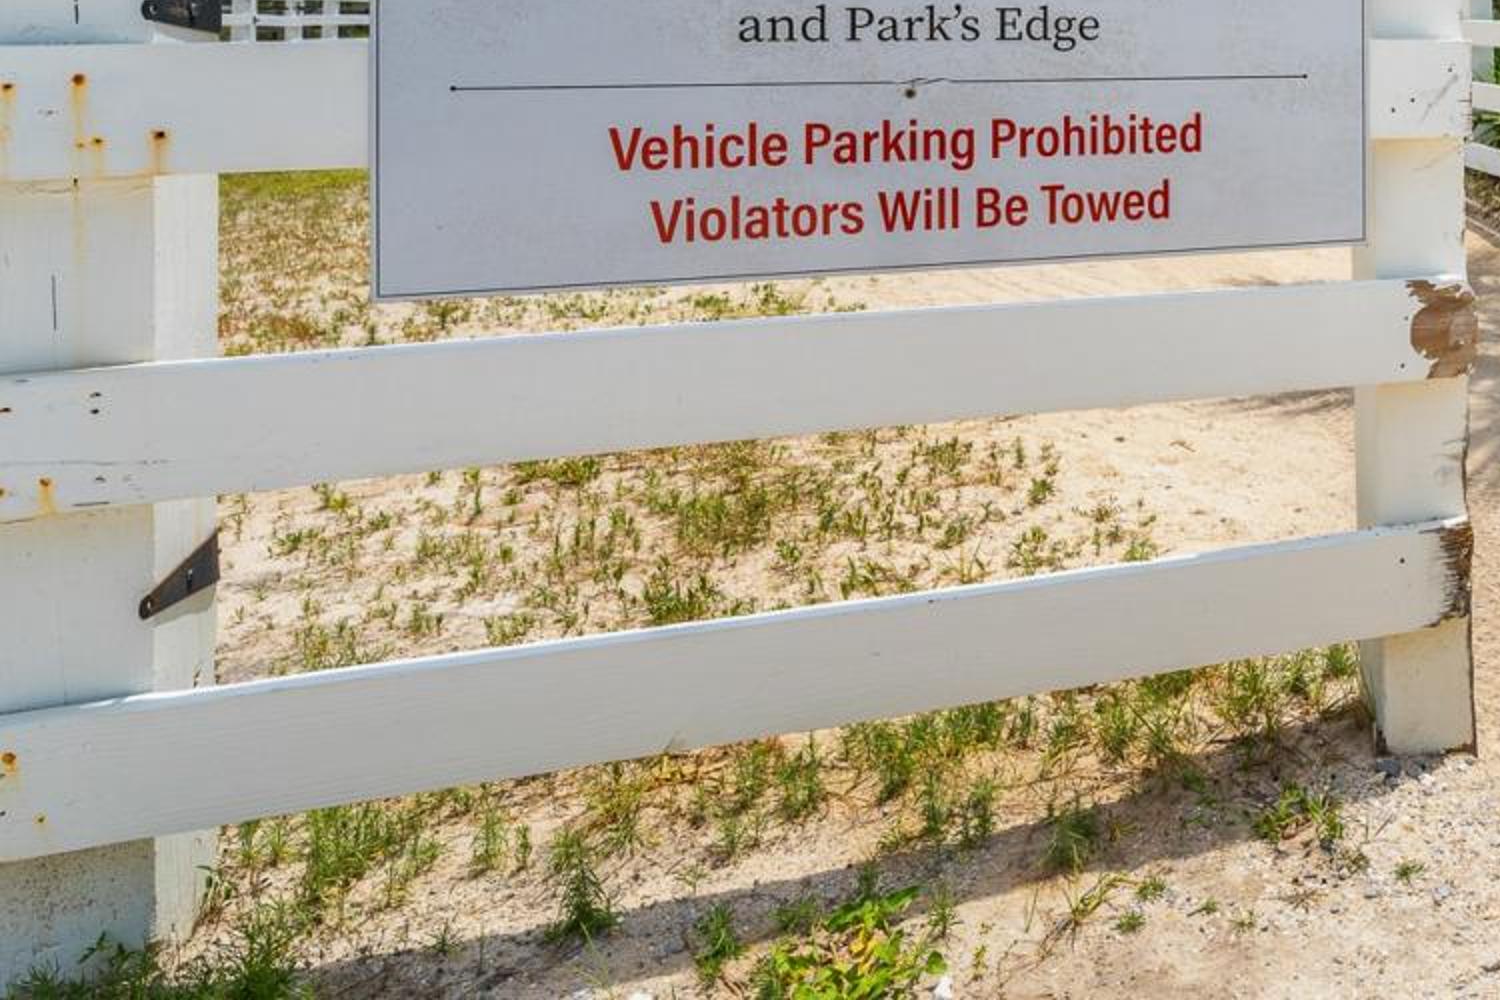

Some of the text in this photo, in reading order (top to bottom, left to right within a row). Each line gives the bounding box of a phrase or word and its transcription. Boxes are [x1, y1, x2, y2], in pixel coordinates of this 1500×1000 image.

[738, 4, 829, 42] and
[995, 5, 1100, 52] Edge
[608, 112, 1202, 171] Vehicle Parking Prohibited
[650, 178, 1170, 244] Violators Will Be Towed
